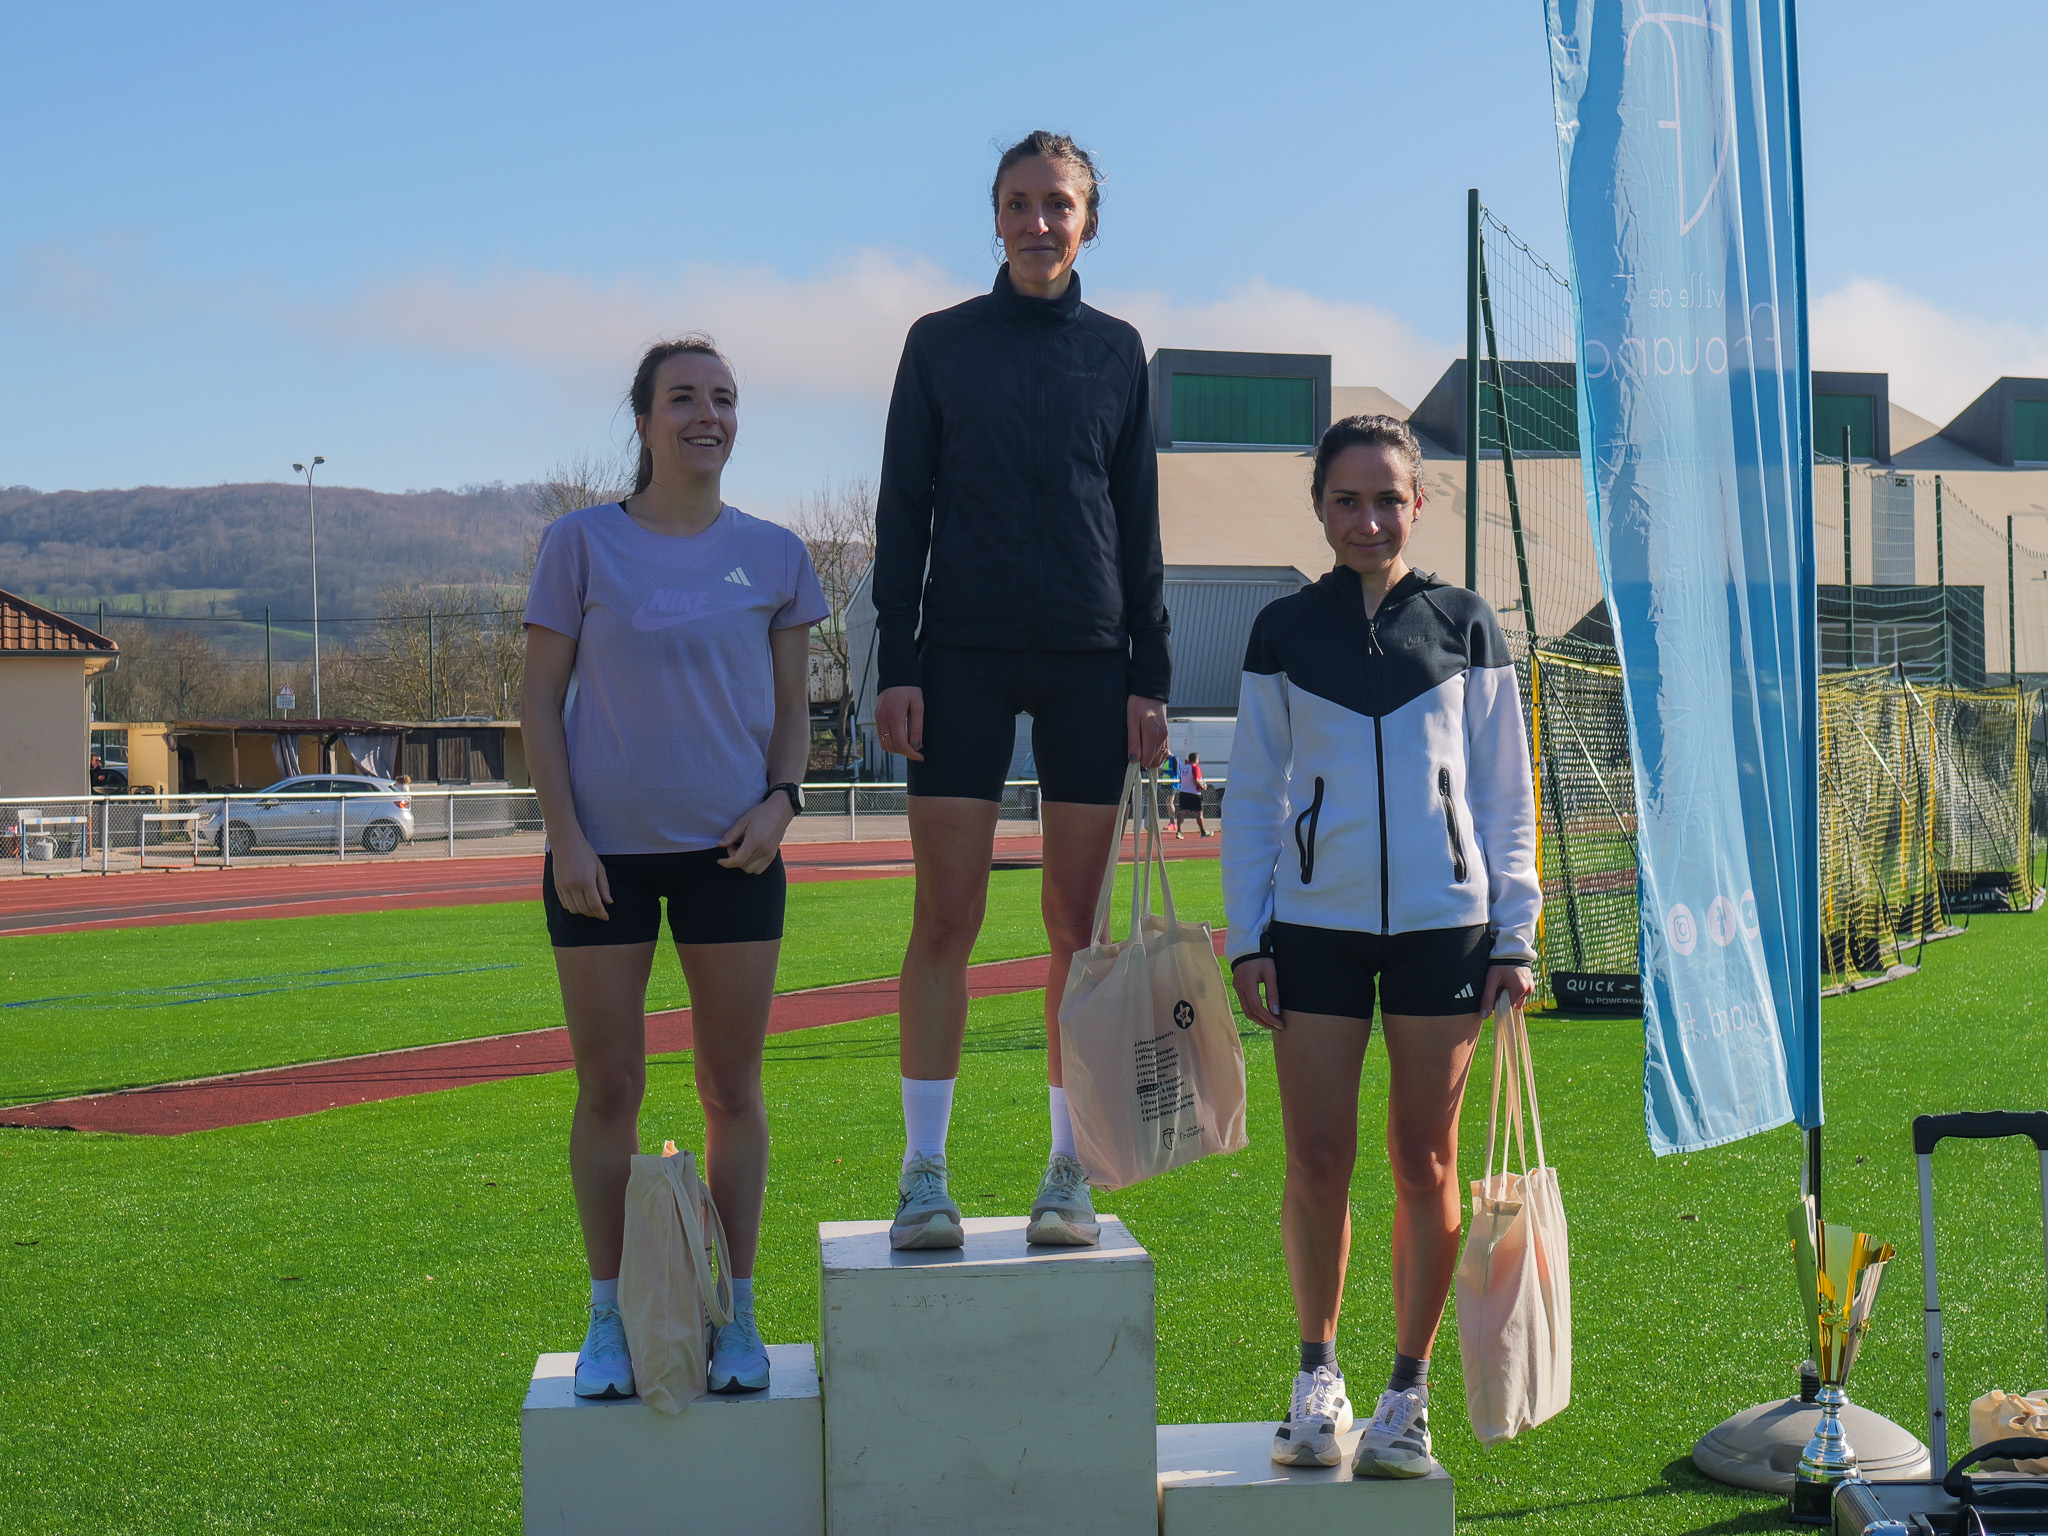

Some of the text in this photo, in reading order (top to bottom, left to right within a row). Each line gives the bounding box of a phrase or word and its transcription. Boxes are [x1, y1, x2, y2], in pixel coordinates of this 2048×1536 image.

[648, 588, 709, 611] NIKE
[1973, 892, 1996, 902] FIRE
[1566, 978, 1615, 992] QUICK
[1585, 996, 1595, 1006] by
[1180, 1124, 1205, 1140] frouard
